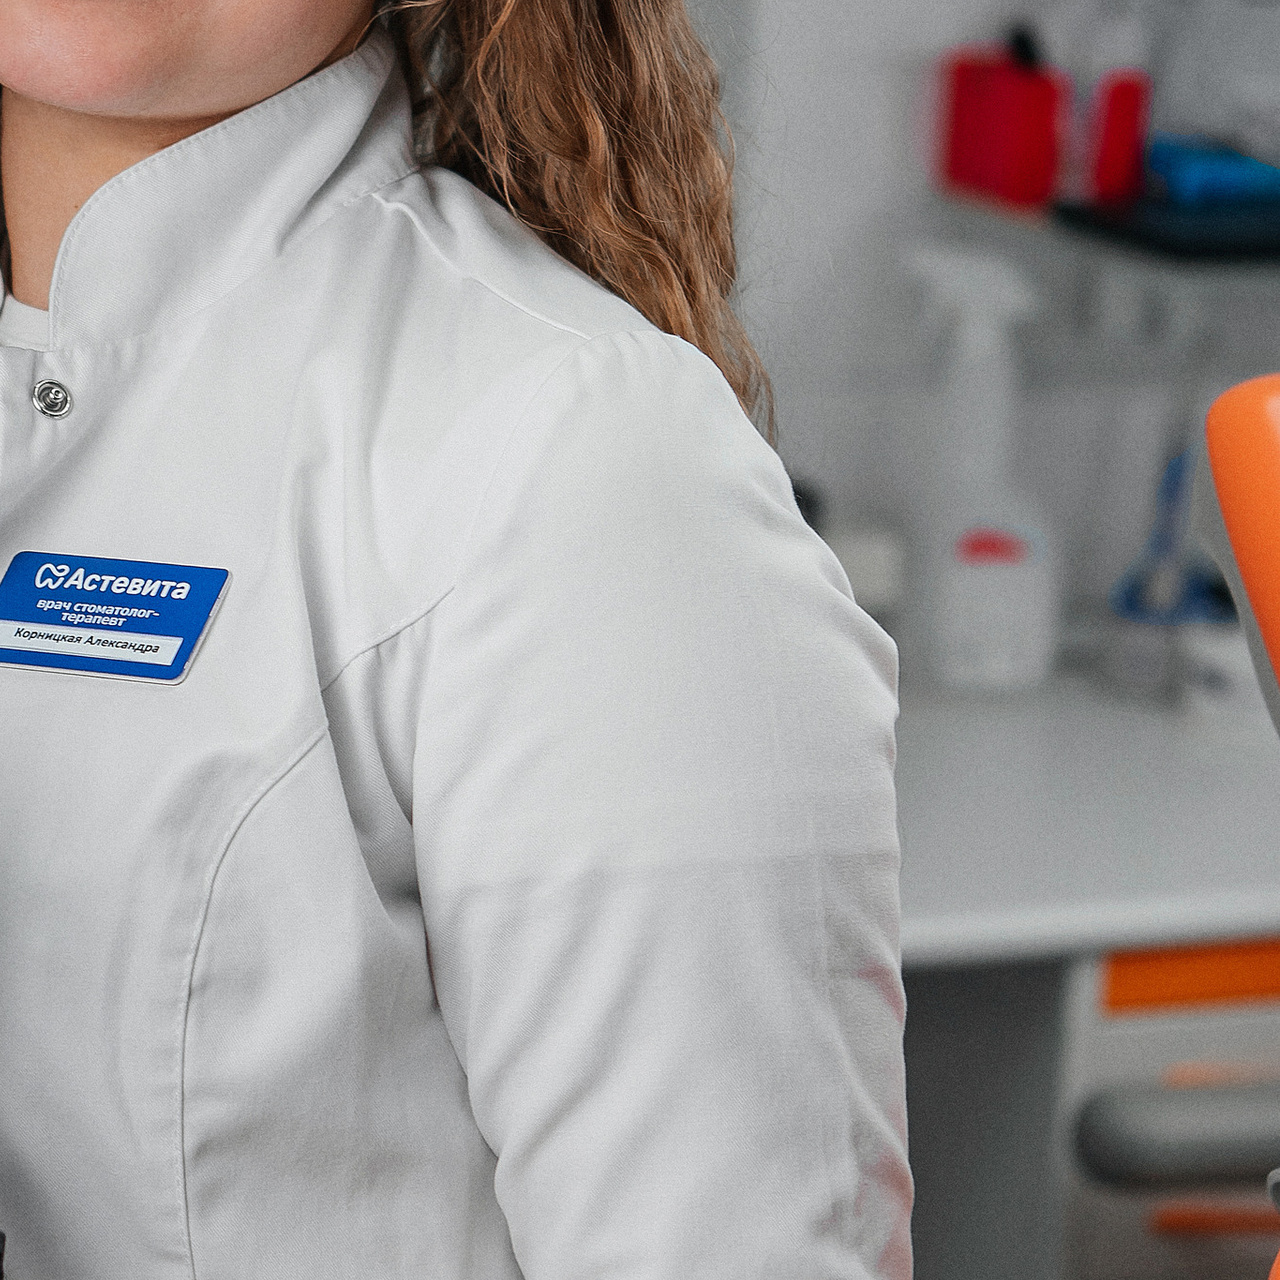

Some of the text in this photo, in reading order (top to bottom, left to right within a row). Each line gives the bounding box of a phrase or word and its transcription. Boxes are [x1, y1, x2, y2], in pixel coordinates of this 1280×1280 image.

[64, 567, 191, 600] Астевита
[36, 598, 160, 618] врач стоматолог-
[61, 611, 127, 627] терапевт
[14, 628, 160, 654] Корницкая Александра
